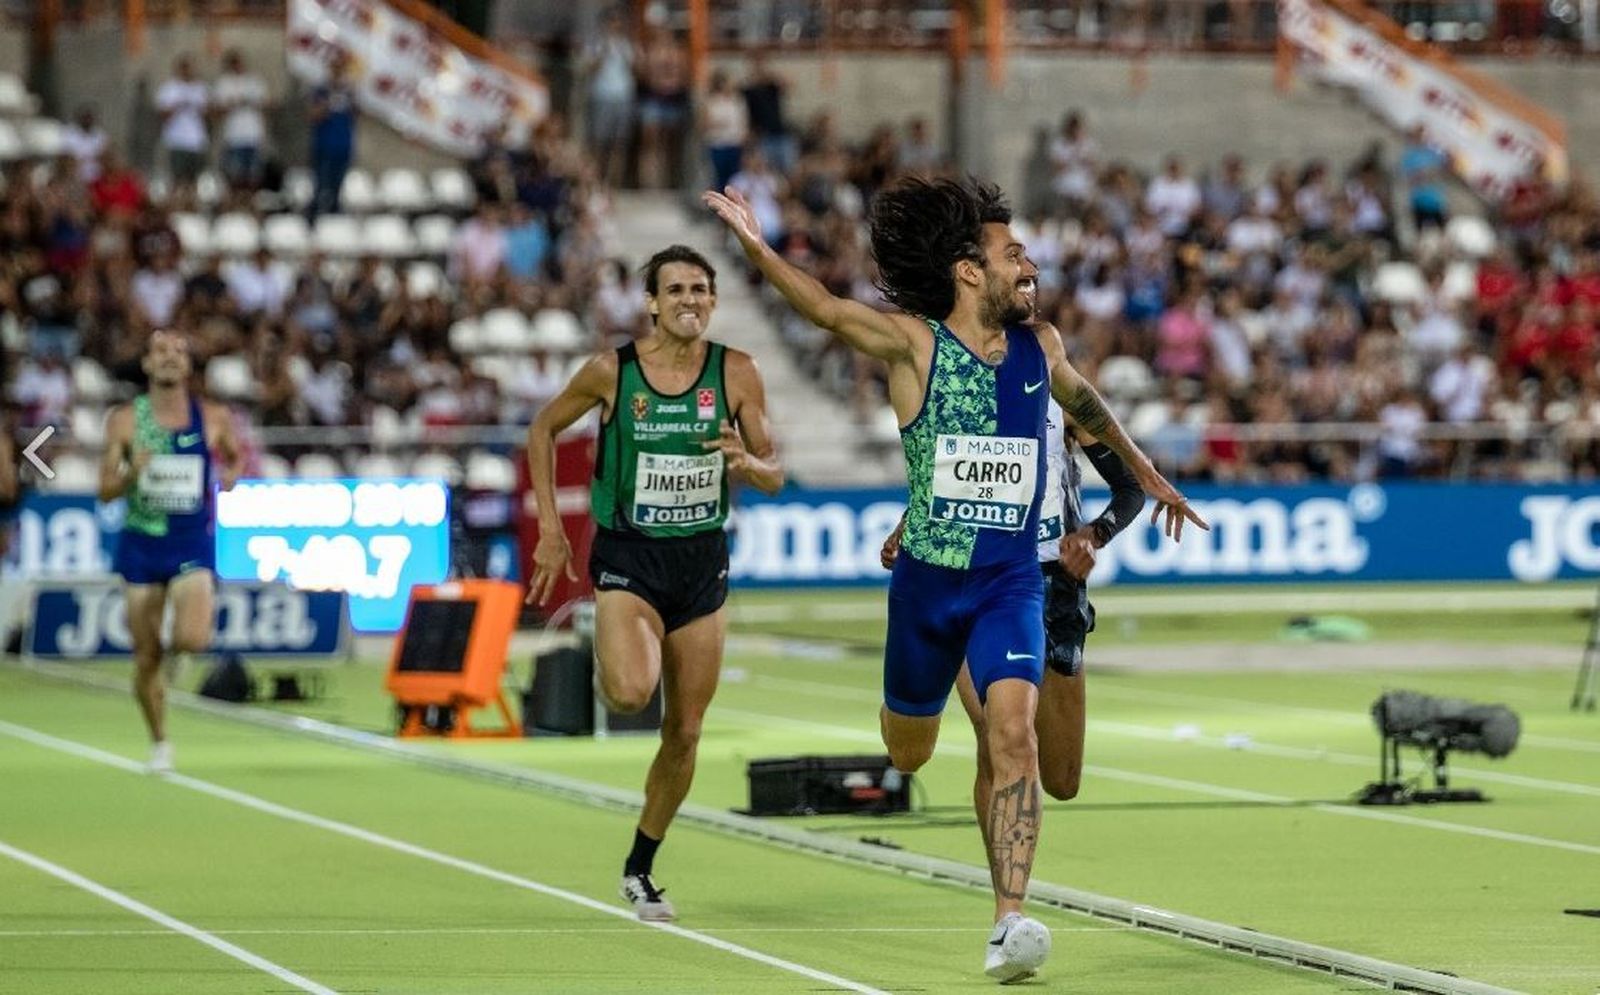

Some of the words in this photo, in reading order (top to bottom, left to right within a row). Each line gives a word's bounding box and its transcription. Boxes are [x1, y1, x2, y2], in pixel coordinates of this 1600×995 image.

[965, 441, 1032, 456] MADRID
[643, 470, 714, 492] JIMENEZ
[953, 460, 1022, 484] CARRO
[977, 487, 994, 500] 28
